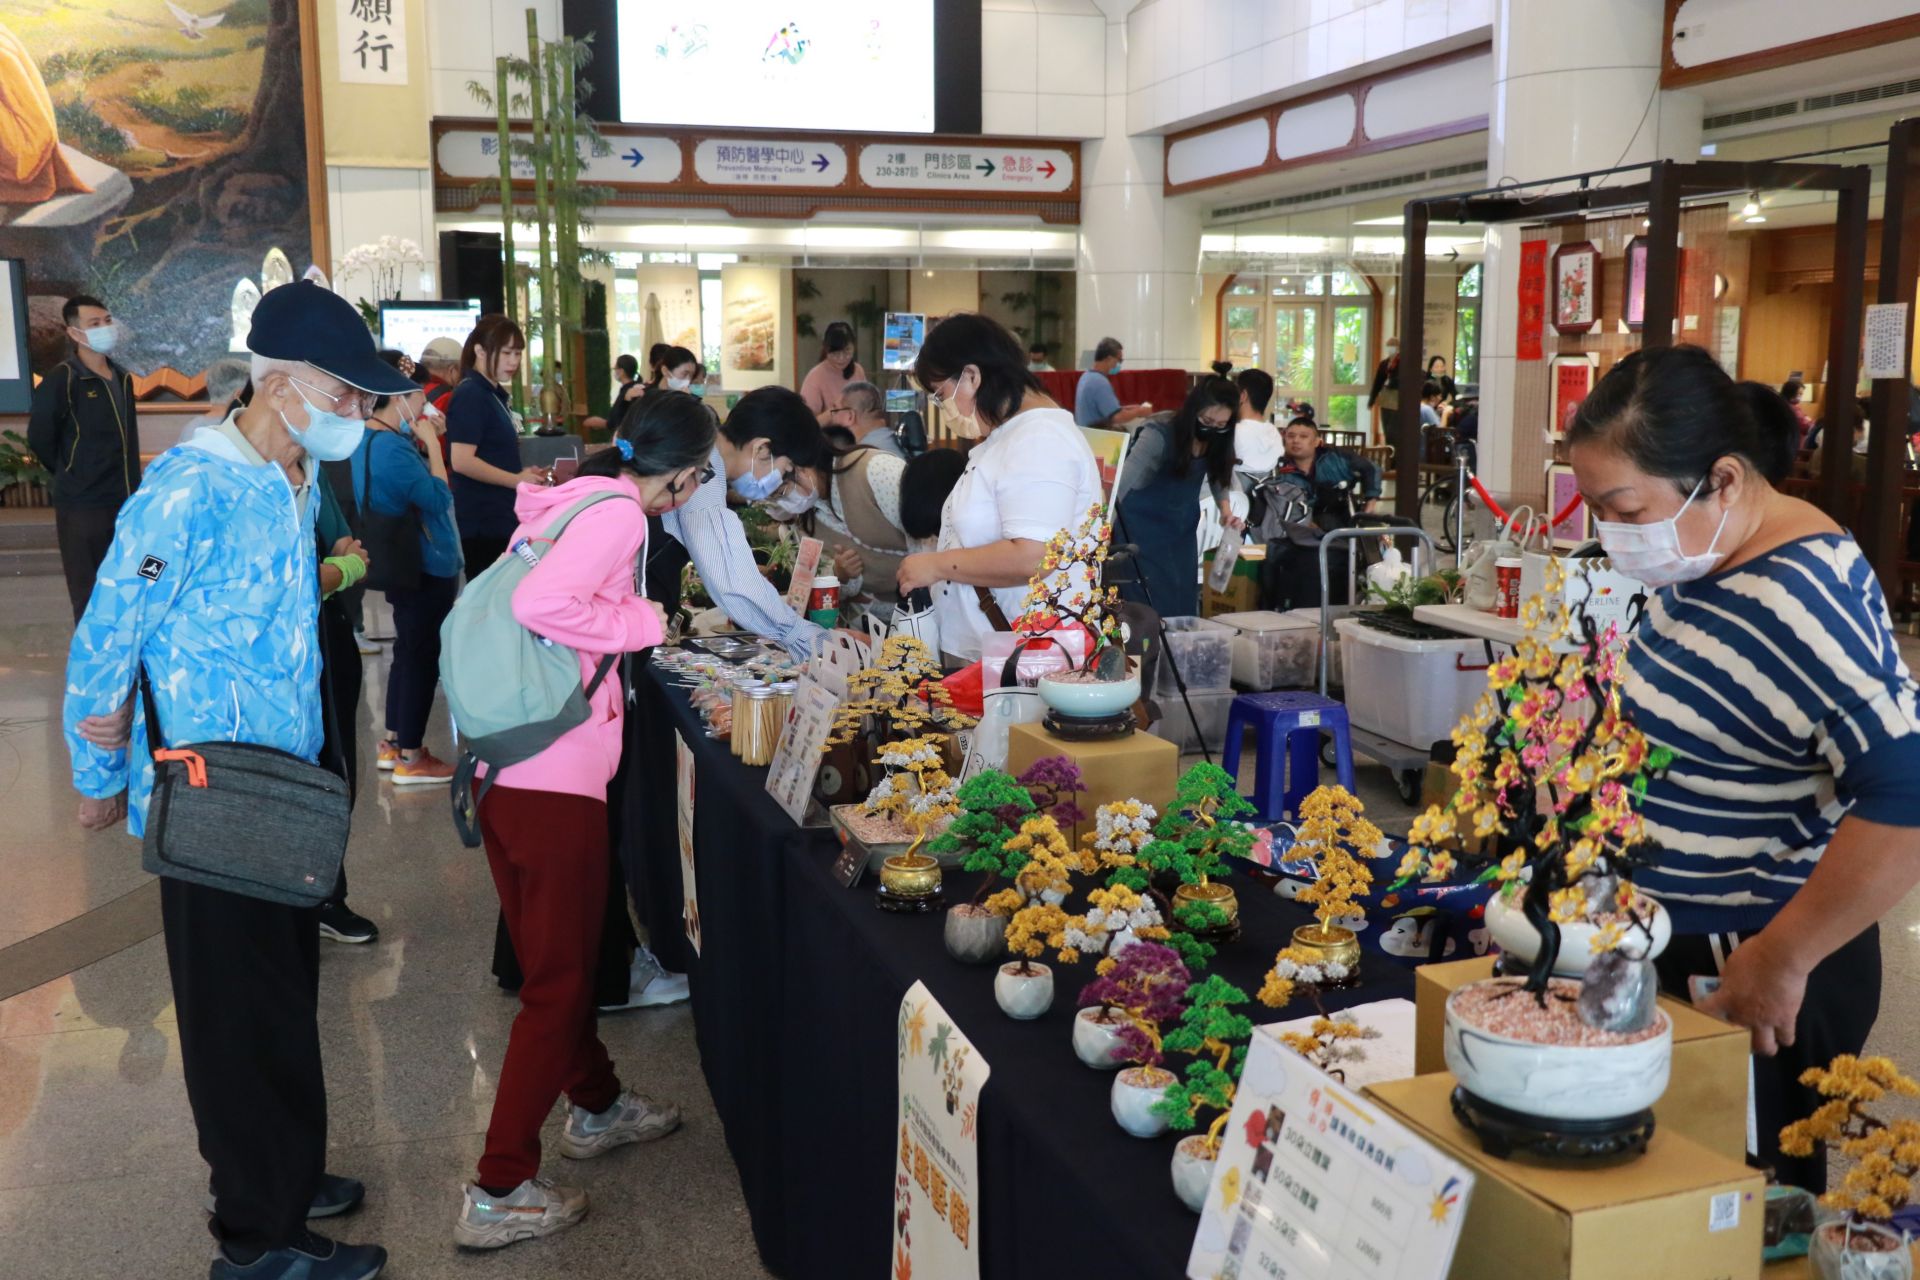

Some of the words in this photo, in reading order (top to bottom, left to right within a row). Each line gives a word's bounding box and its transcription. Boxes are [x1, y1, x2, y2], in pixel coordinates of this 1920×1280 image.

[716, 145, 805, 165] 預防醫學中心
[924, 153, 972, 170] 門診區
[716, 163, 751, 172] Preventive
[754, 165, 782, 173] Medicine
[784, 166, 806, 174] Center
[1002, 155, 1033, 173] 急診
